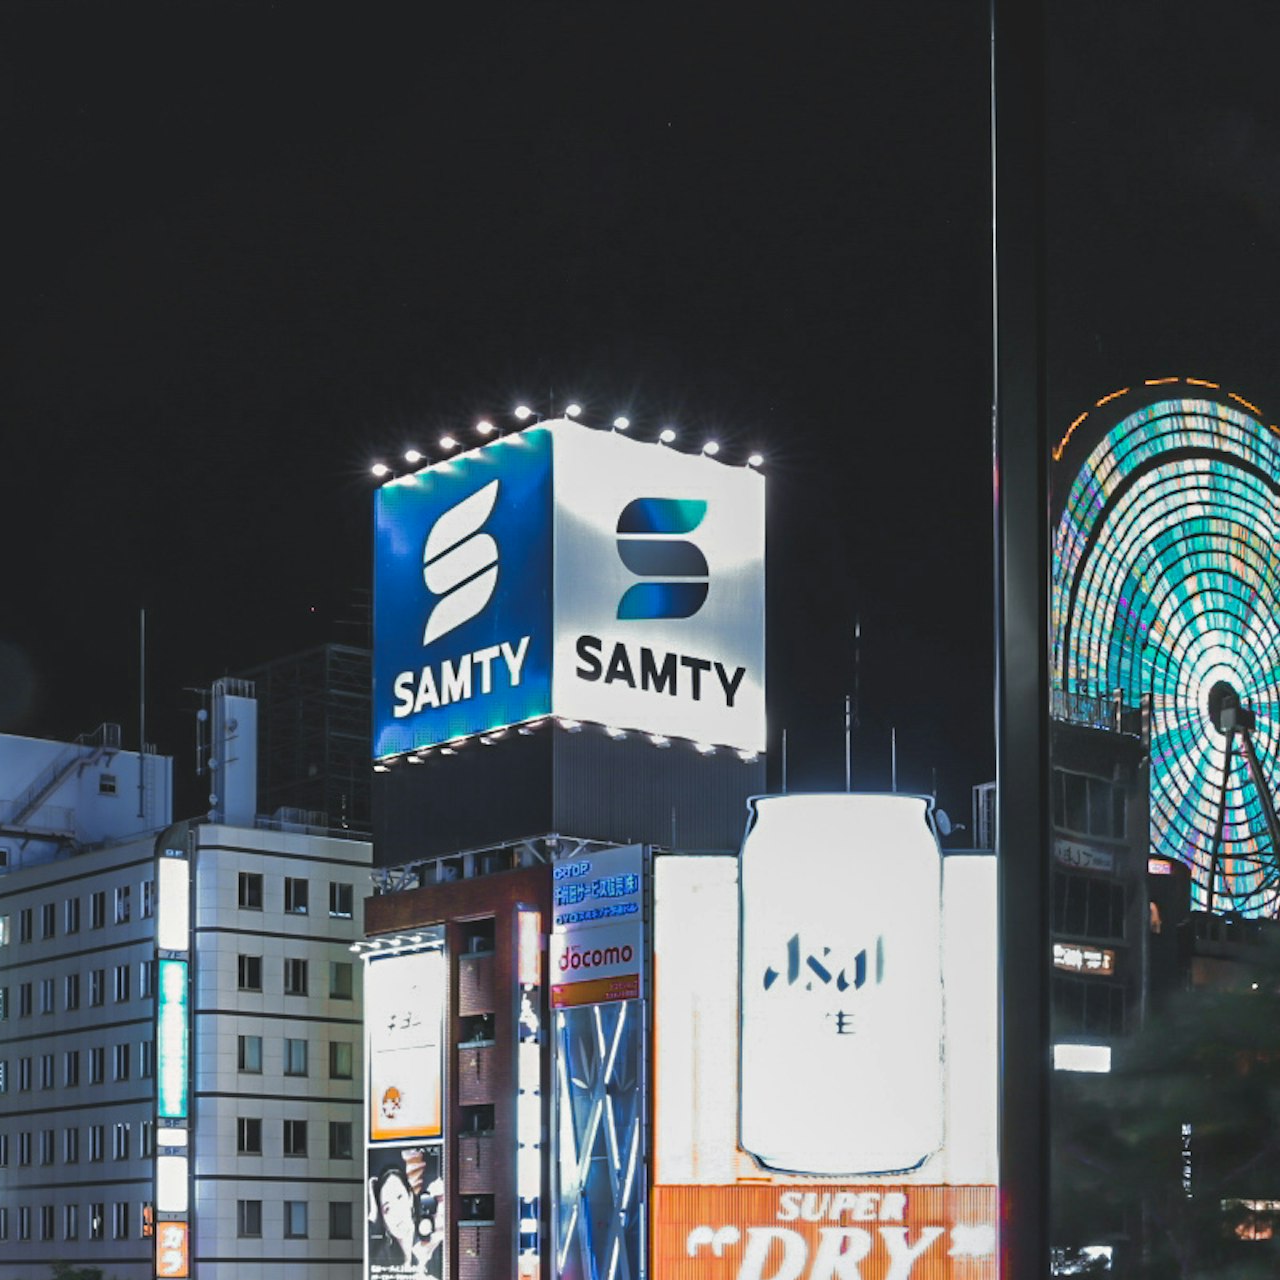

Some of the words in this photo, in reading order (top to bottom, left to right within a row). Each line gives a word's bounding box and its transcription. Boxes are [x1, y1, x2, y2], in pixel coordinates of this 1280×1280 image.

[393, 636, 531, 719] SAMTY
[576, 634, 746, 707] SAMTY
[558, 944, 633, 972] docomo
[776, 1190, 908, 1222] SUPER
